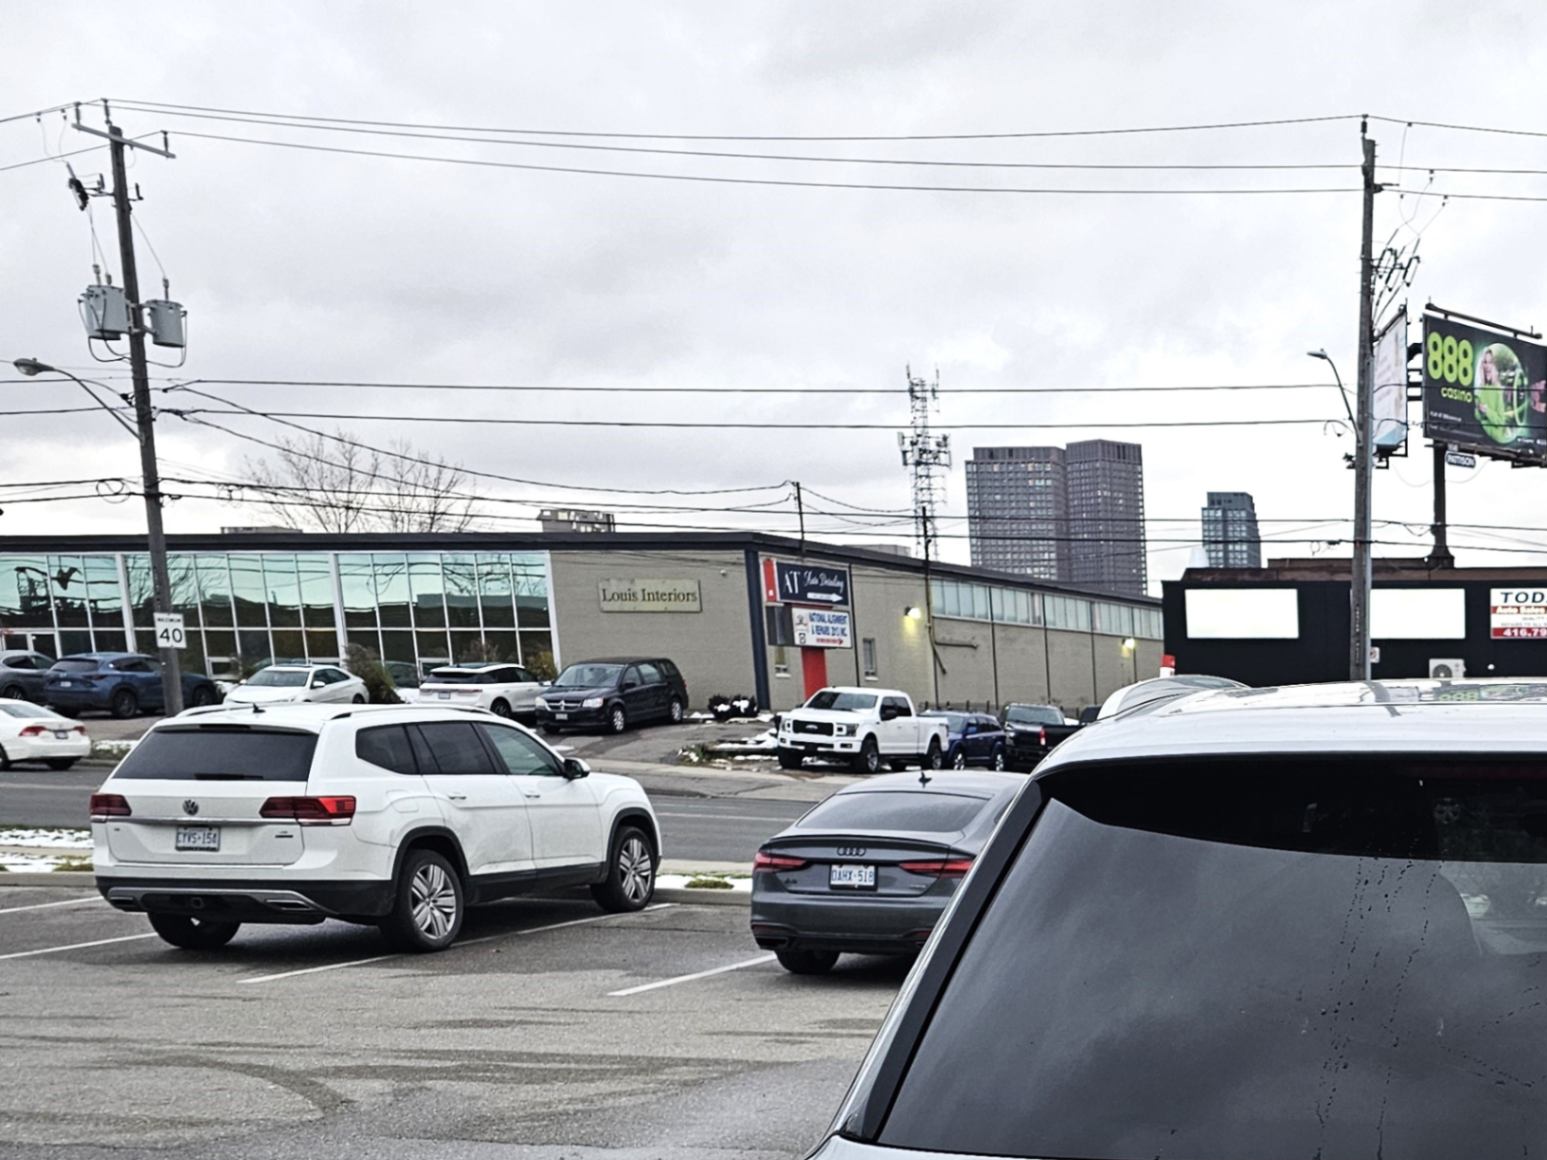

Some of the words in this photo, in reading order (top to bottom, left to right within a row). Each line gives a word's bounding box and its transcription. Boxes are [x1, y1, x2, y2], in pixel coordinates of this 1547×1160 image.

[1427, 331, 1473, 386] 888
[1441, 387, 1472, 403] casino
[602, 588, 638, 602] Louis
[641, 588, 697, 602] Interiors
[159, 628, 183, 643] 40
